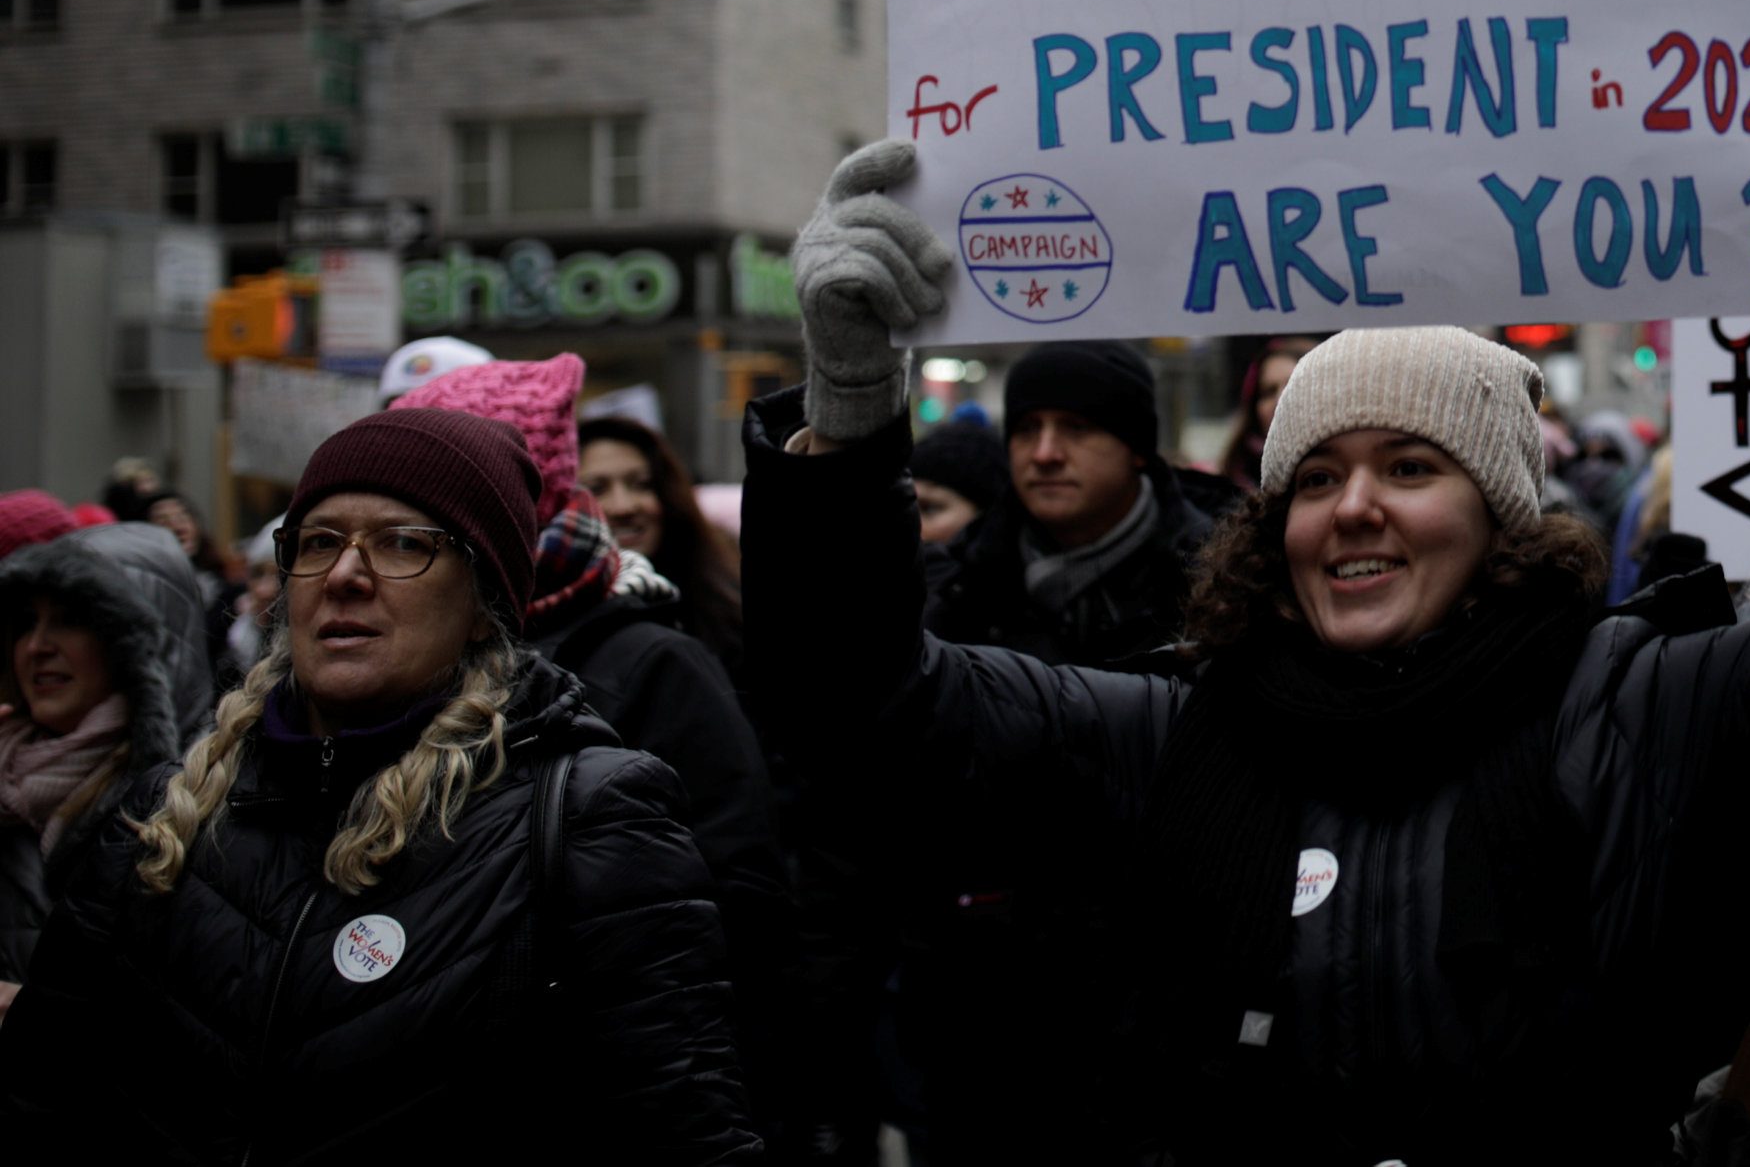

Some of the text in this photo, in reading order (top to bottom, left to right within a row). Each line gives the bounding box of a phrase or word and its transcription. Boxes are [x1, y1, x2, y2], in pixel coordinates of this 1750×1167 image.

[906, 74, 998, 139] for
[1032, 16, 1569, 151] PRESIDENT
[1590, 69, 1624, 110] in
[967, 233, 1100, 262] CAMPAIGN
[1183, 184, 1404, 314] ARE
[1296, 884, 1318, 896] OTE
[356, 921, 375, 938] THE
[349, 945, 378, 973] VOTE
